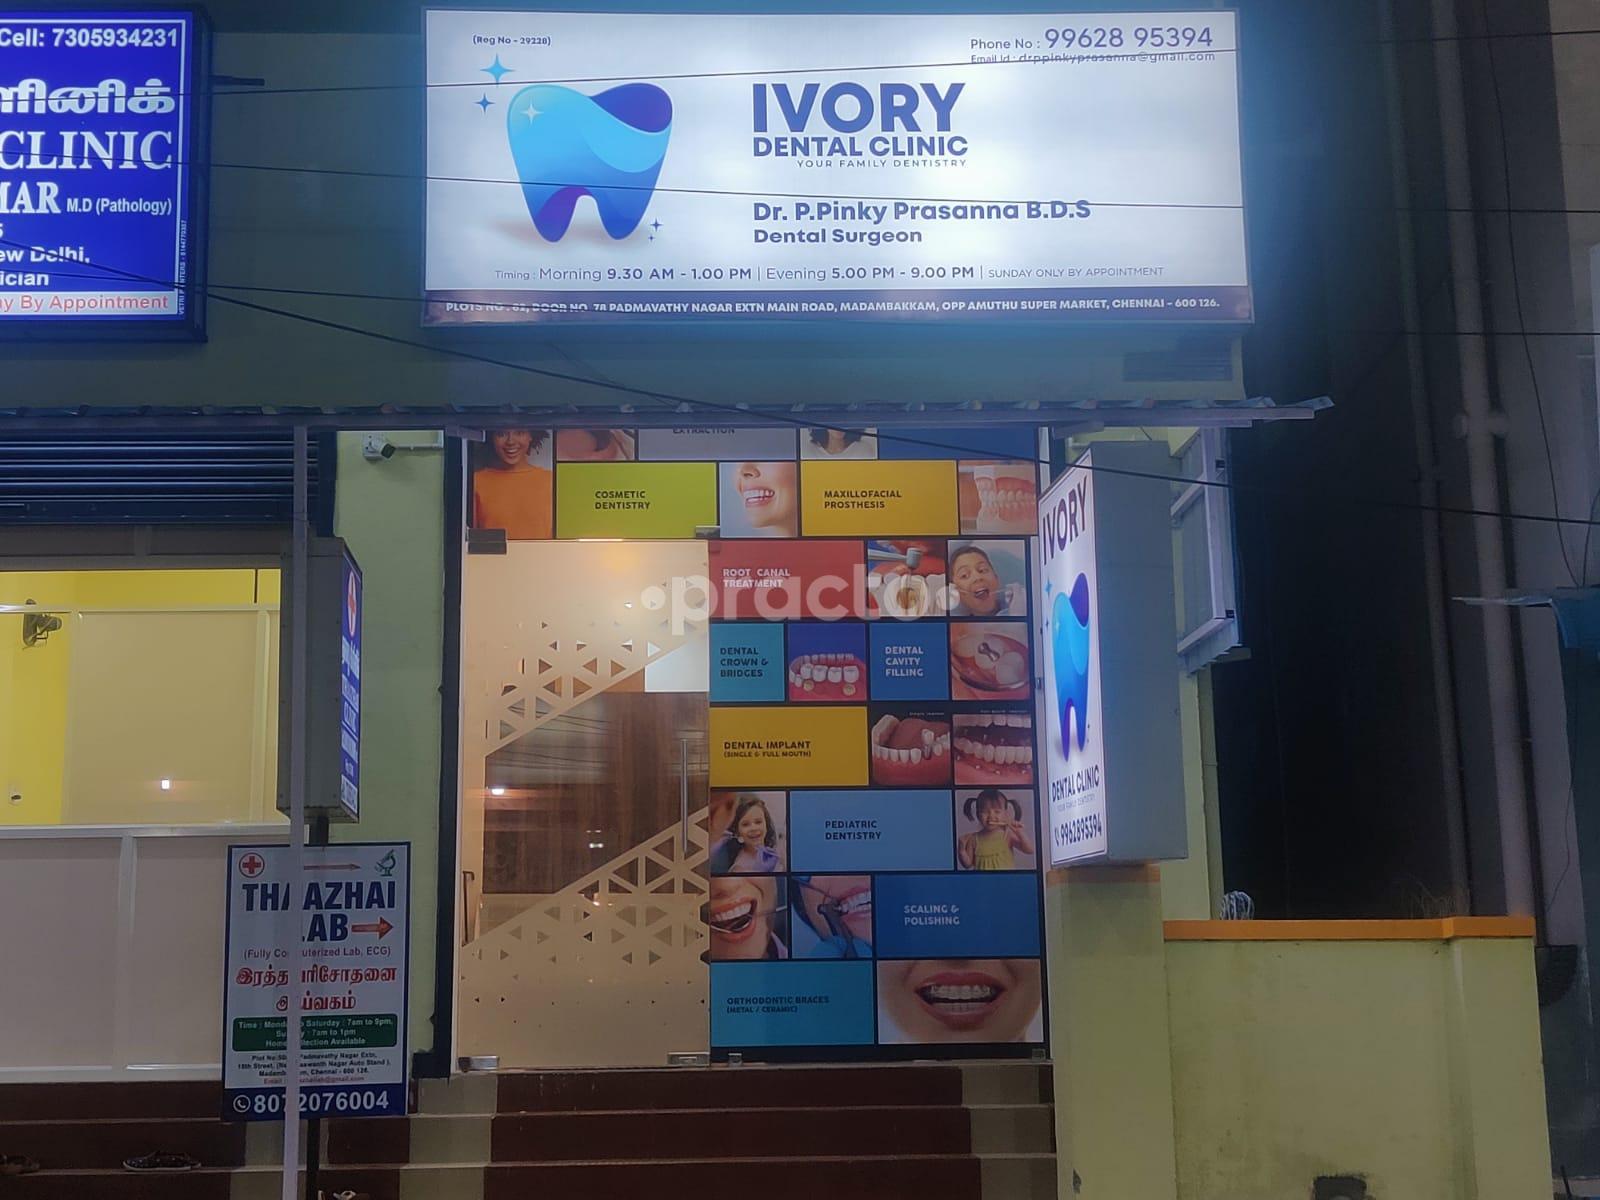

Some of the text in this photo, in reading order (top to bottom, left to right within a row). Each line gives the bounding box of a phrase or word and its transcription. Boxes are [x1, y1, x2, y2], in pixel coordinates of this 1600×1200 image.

[0, 28, 177, 47] Cell: 7305934231
[472, 34, 495, 46] (Reg
[498, 35, 511, 45] No
[520, 35, 551, 47] 29228)
[970, 38, 1011, 50] Phone
[1015, 38, 1033, 49] No
[1045, 27, 1124, 48] 99628
[1134, 27, 1213, 48] 95394
[971, 54, 998, 64] Email
[752, 82, 966, 133] IVORY
[0, 130, 172, 169] CLINIC
[753, 136, 969, 157] DENTAL CLINIC
[797, 159, 967, 168] YOUR FAMILY DENTISTRY
[66, 198, 93, 213] M.D
[96, 197, 173, 216] (Pathology)
[753, 200, 1091, 225] Dr. P.Pinky Prasanna B.D.S
[753, 227, 923, 247] Dental Surgeon
[30, 246, 91, 264] Delhi,
[494, 270, 530, 282] Timing
[539, 267, 602, 283] Morning
[607, 269, 644, 281] 9.30
[649, 268, 674, 280] AM
[691, 268, 724, 281] 1.00
[729, 268, 752, 280] PM
[766, 267, 826, 282] Evening
[831, 267, 869, 280] 5.00
[872, 267, 895, 279] PM
[911, 266, 947, 279] 9.00
[951, 266, 975, 279] PM
[988, 268, 1033, 279] SUNDAY
[1036, 267, 1065, 278] ONLY
[1068, 267, 1083, 278] BY
[1085, 266, 1164, 277] APPOINTMENT
[21, 295, 44, 312] By
[50, 294, 169, 313] Appointment
[608, 303, 689, 313] PADMAVATHY
[691, 303, 733, 313] NAGAR
[735, 303, 765, 313] EXTN
[767, 302, 799, 312] MAIN
[801, 302, 838, 313] ROAD,
[839, 301, 941, 313] MADAMBAKKAM,
[942, 301, 966, 311] OPP
[967, 301, 1018, 311] AMUTHU
[1020, 300, 1057, 310] SUPER
[1059, 300, 1111, 311] MARKET,
[1112, 299, 1165, 309] CHENNAI
[1174, 299, 1197, 308] 600
[1199, 298, 1220, 308] 126.
[594, 490, 647, 500] COSMETIC
[824, 490, 902, 499] MAXILLOFACIAL
[594, 501, 651, 511] DENTISTRY
[824, 500, 886, 510] PROSTHESIS
[1042, 474, 1088, 566] IVORY
[722, 567, 791, 578] ROOT CANAL
[722, 578, 784, 589] TREATMENT
[719, 647, 760, 656] DENTAL
[885, 646, 925, 656] DENTAL
[719, 657, 760, 667] CROWN
[885, 657, 921, 666] CAVITY
[719, 668, 764, 678] BRIDGES
[885, 668, 924, 677] FILLING
[723, 740, 811, 750] DENTAL IMPLANT
[1051, 774, 1076, 803] DENTAL
[1076, 764, 1100, 794] CLINIC
[825, 820, 878, 829] PEDIATRIC
[825, 831, 882, 841] DENTISTRY
[903, 904, 949, 914] SCALING
[903, 916, 961, 926] POLISHING
[301, 912, 350, 943] AB
[244, 948, 271, 960] (Fully
[274, 946, 341, 957] Couterized
[366, 945, 392, 957] ECG)
[726, 995, 831, 1005] ORTHODONTIC BRACES
[238, 1021, 257, 1029] Time
[306, 1019, 340, 1028] Saturday
[347, 1018, 363, 1026] 7am
[340, 1028, 356, 1037] 1pm
[330, 1036, 366, 1045] Available
[311, 1067, 338, 1075] Chennai
